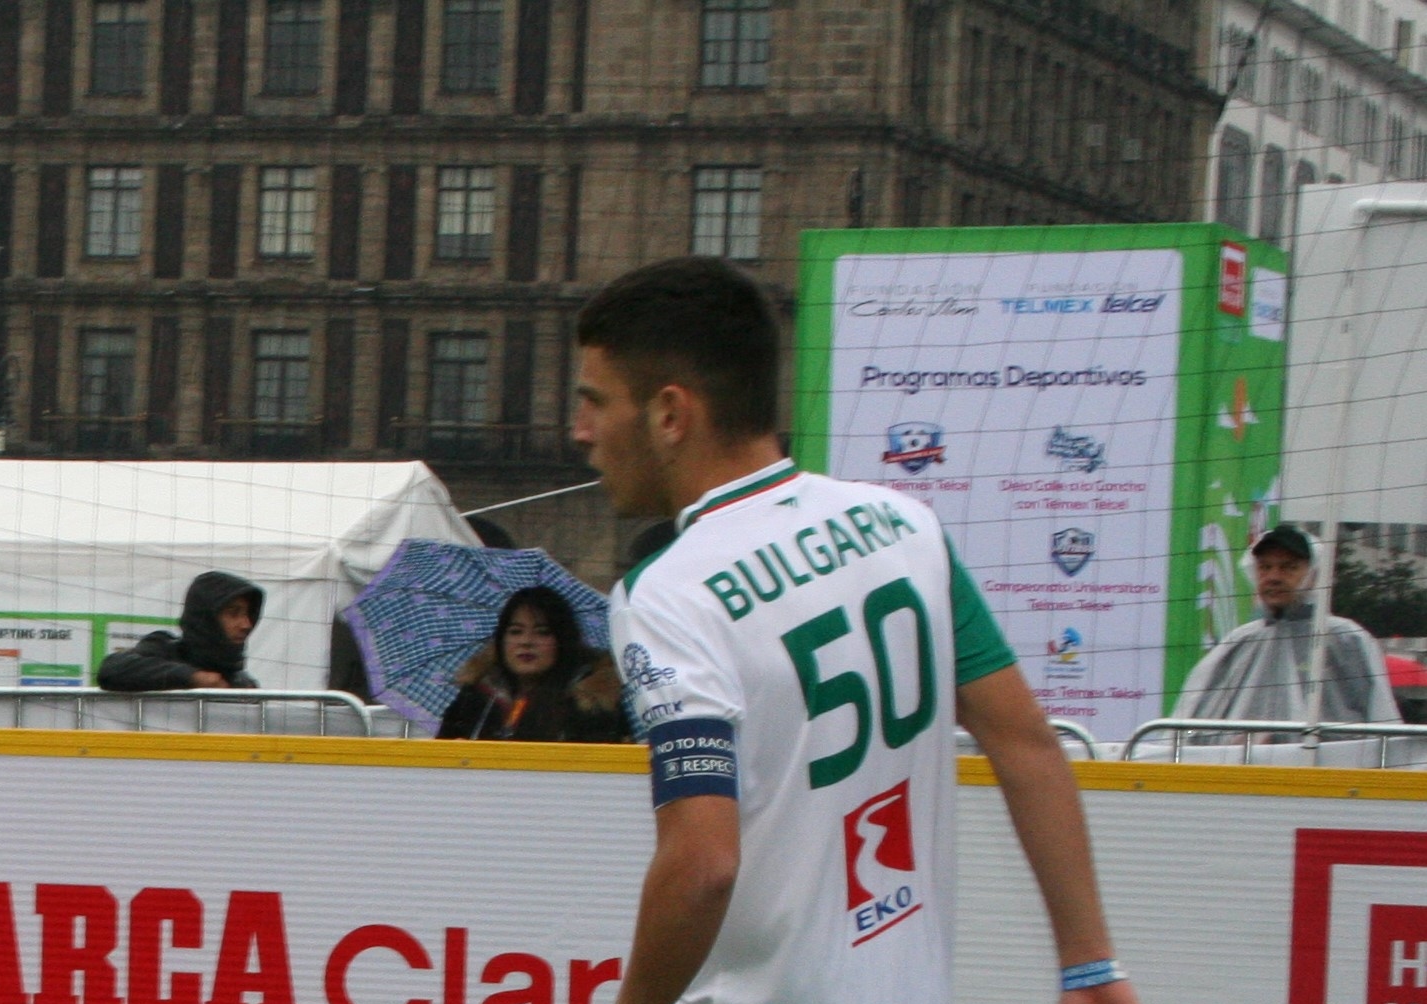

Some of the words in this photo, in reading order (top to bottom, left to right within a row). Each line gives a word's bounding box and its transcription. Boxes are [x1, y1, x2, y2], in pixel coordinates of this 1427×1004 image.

[1000, 298, 1094, 313] TELMEX
[861, 365, 1001, 395] Programas
[1005, 364, 1147, 391] Deportivos
[780, 577, 937, 790] 50
[676, 738, 695, 749] TO
[683, 759, 735, 773] RESPEC
[855, 885, 913, 932] EKO
